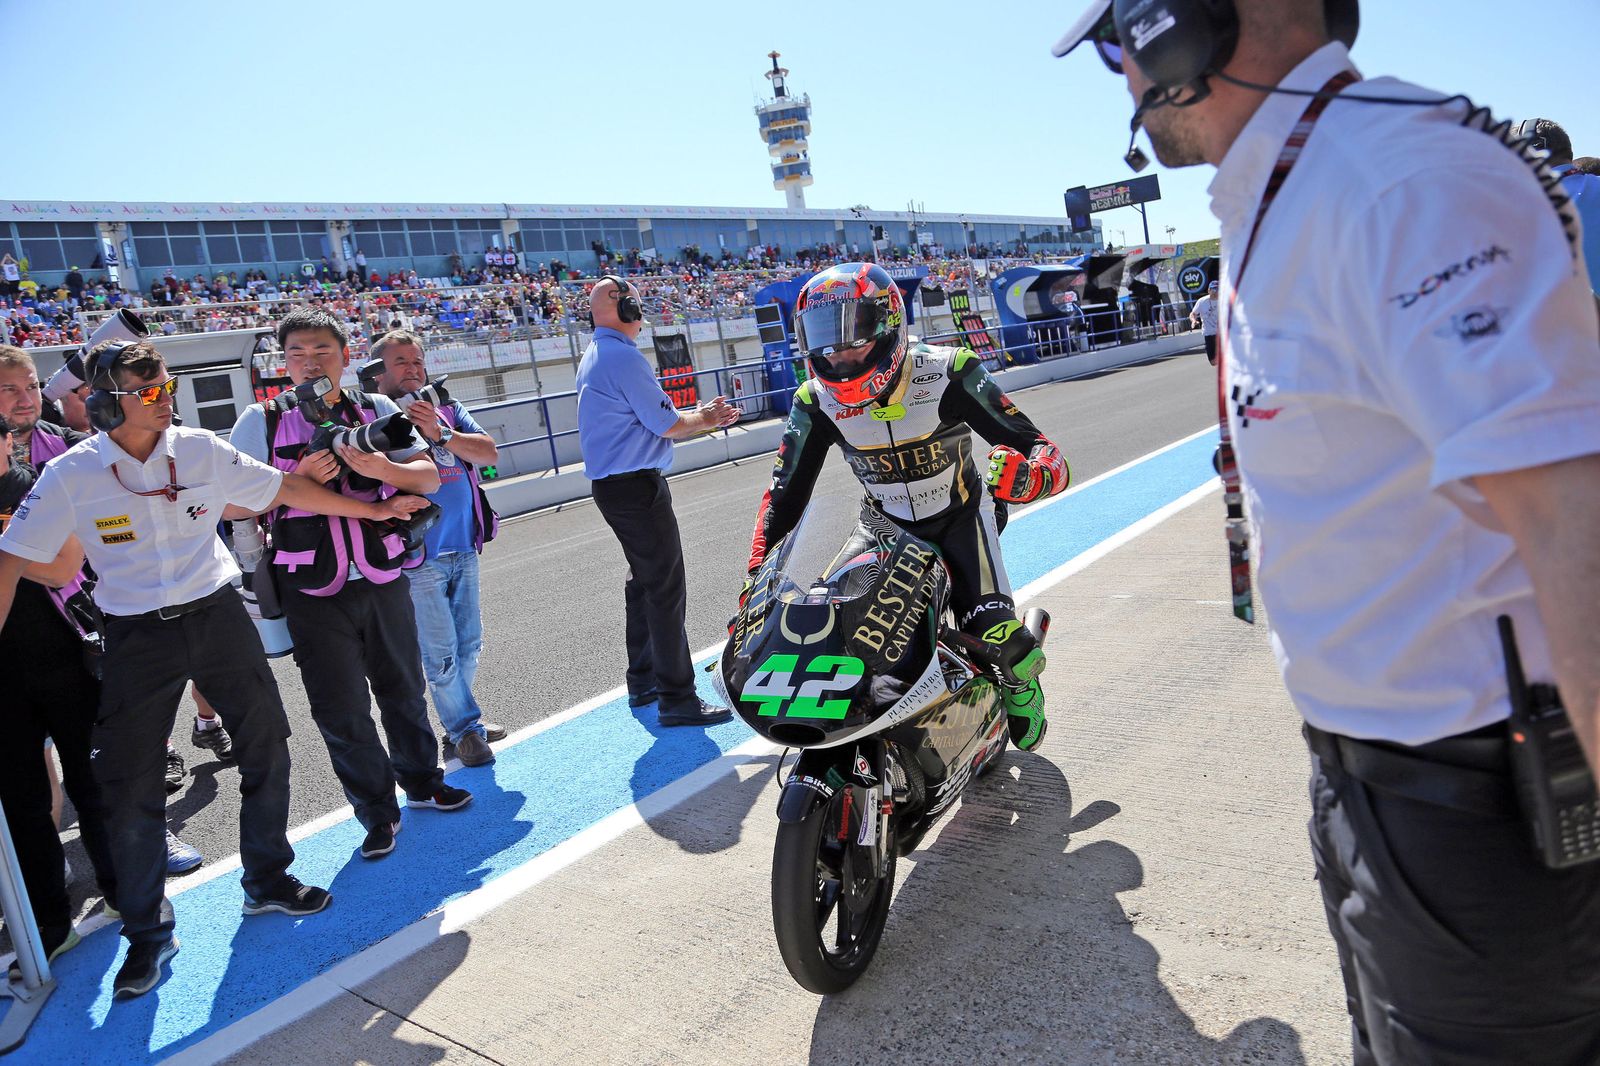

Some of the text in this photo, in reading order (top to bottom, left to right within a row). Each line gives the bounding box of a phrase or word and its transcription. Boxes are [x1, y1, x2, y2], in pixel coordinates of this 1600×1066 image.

[887, 268, 917, 278] SUZUKI
[1184, 273, 1200, 283] sky
[871, 352, 902, 392] Red
[917, 374, 938, 382] HJC
[835, 407, 864, 420] KTM
[851, 441, 946, 473] BESTER
[96, 517, 129, 528] STANLEY
[852, 543, 934, 653] BESTER
[885, 598, 928, 662] CAPITAL
[740, 654, 865, 720] 42
[888, 682, 929, 720] PLATINUM
